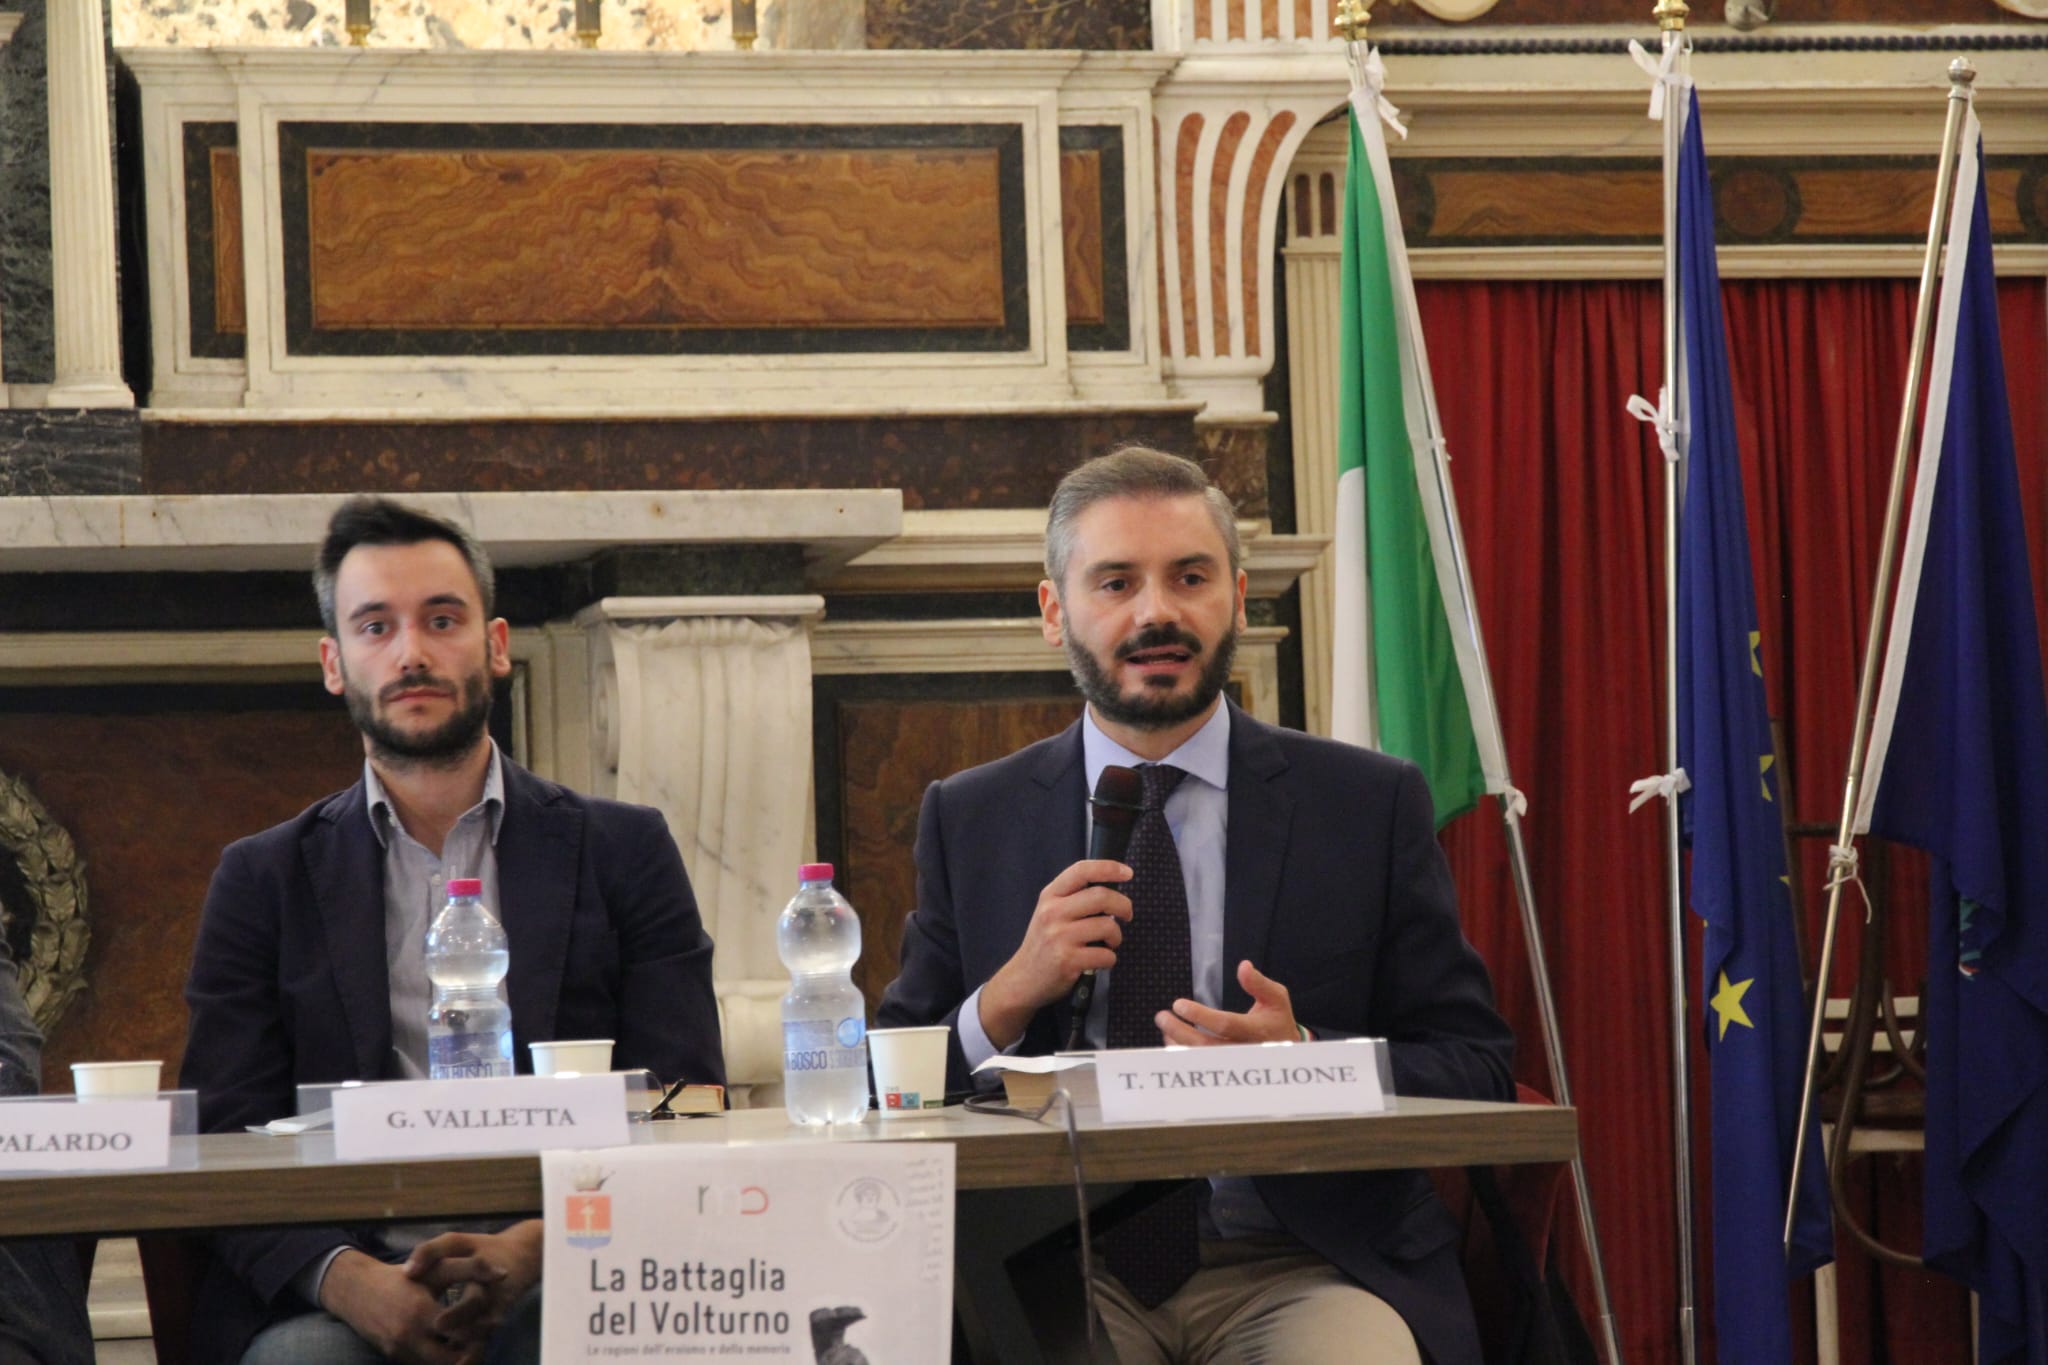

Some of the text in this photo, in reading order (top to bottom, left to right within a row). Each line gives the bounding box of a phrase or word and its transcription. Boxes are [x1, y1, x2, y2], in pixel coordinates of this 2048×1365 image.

[1118, 1065, 1358, 1091] T. TARTAGLIONE
[387, 1107, 577, 1129] G. VALLETTA
[590, 1258, 786, 1299] La Battaglia
[589, 1301, 791, 1336] del Volturno
